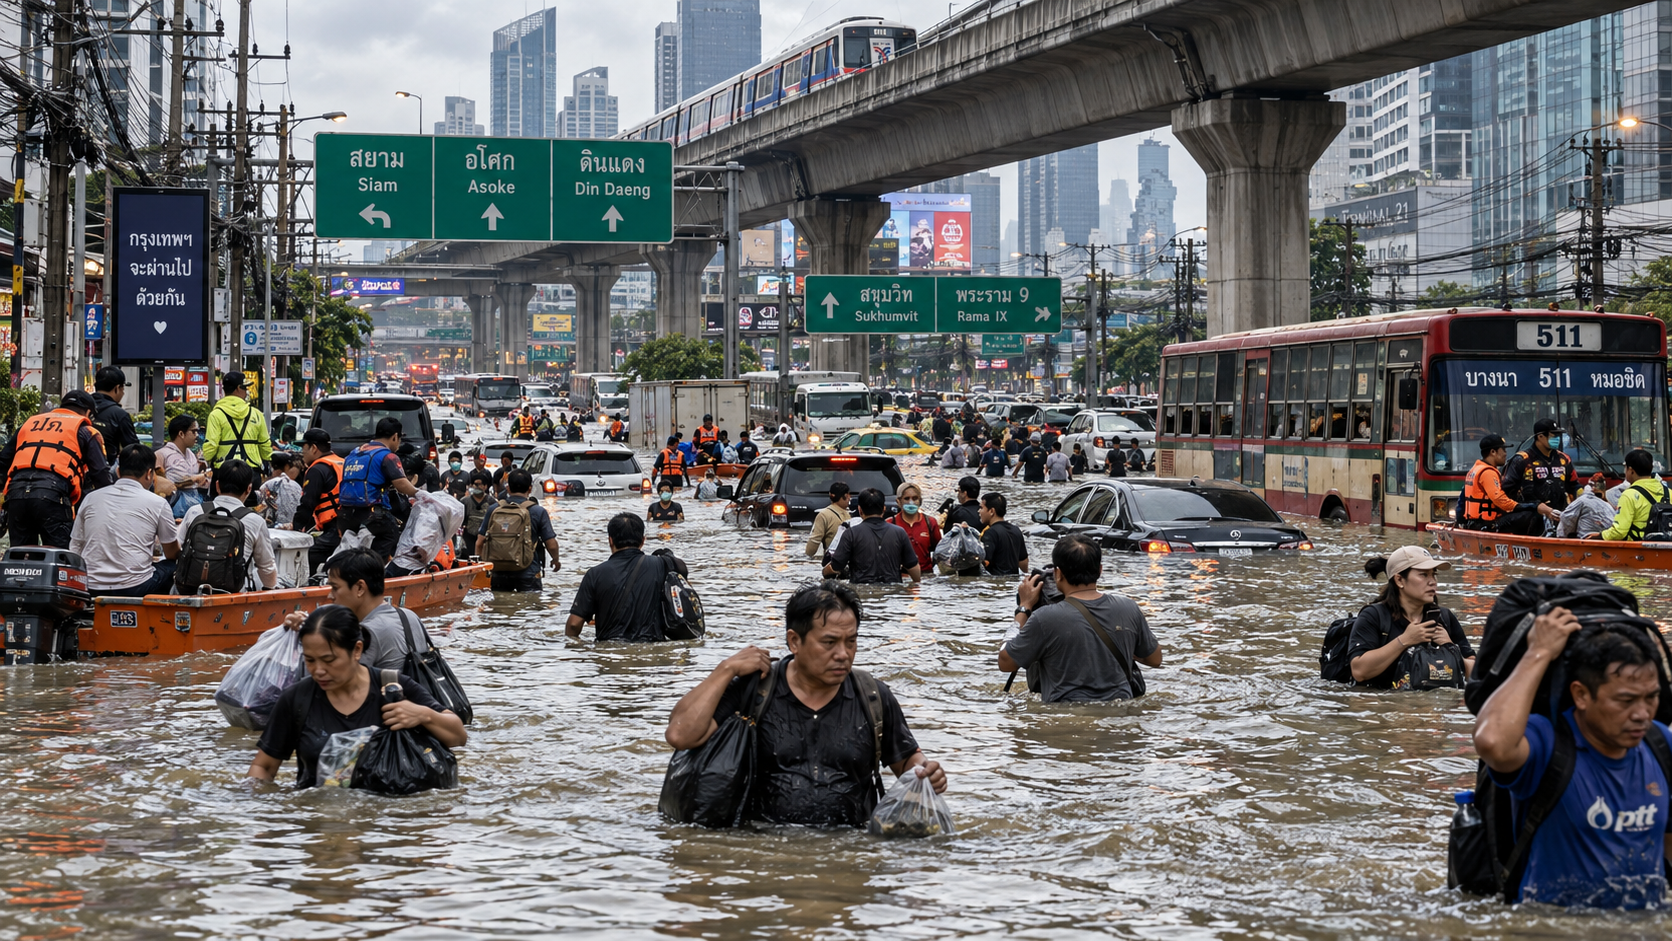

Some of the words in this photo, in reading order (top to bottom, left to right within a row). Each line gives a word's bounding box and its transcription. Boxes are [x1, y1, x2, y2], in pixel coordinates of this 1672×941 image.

[349, 149, 405, 169] สยาม
[465, 144, 515, 171] อโศก
[579, 149, 645, 174] ดินแดง
[358, 177, 398, 193] Siam
[467, 179, 516, 195] Asoke
[575, 181, 600, 196] Din
[604, 181, 651, 200] Daeng
[129, 232, 193, 252] กรุงเทพฯ
[129, 257, 192, 277] จะผ่านไป
[136, 286, 186, 307] ด้วยกัน
[955, 289, 1012, 303] พระราม
[1019, 286, 1030, 303] 9
[855, 310, 919, 322] Sukhumvit
[957, 310, 990, 322] Rama
[995, 310, 1008, 322] IX
[1537, 324, 1583, 348] 511
[1465, 371, 1518, 387] บางนา
[1539, 367, 1572, 388] 511
[1590, 366, 1646, 389] หมอชิต
[1614, 803, 1658, 832] ptt
